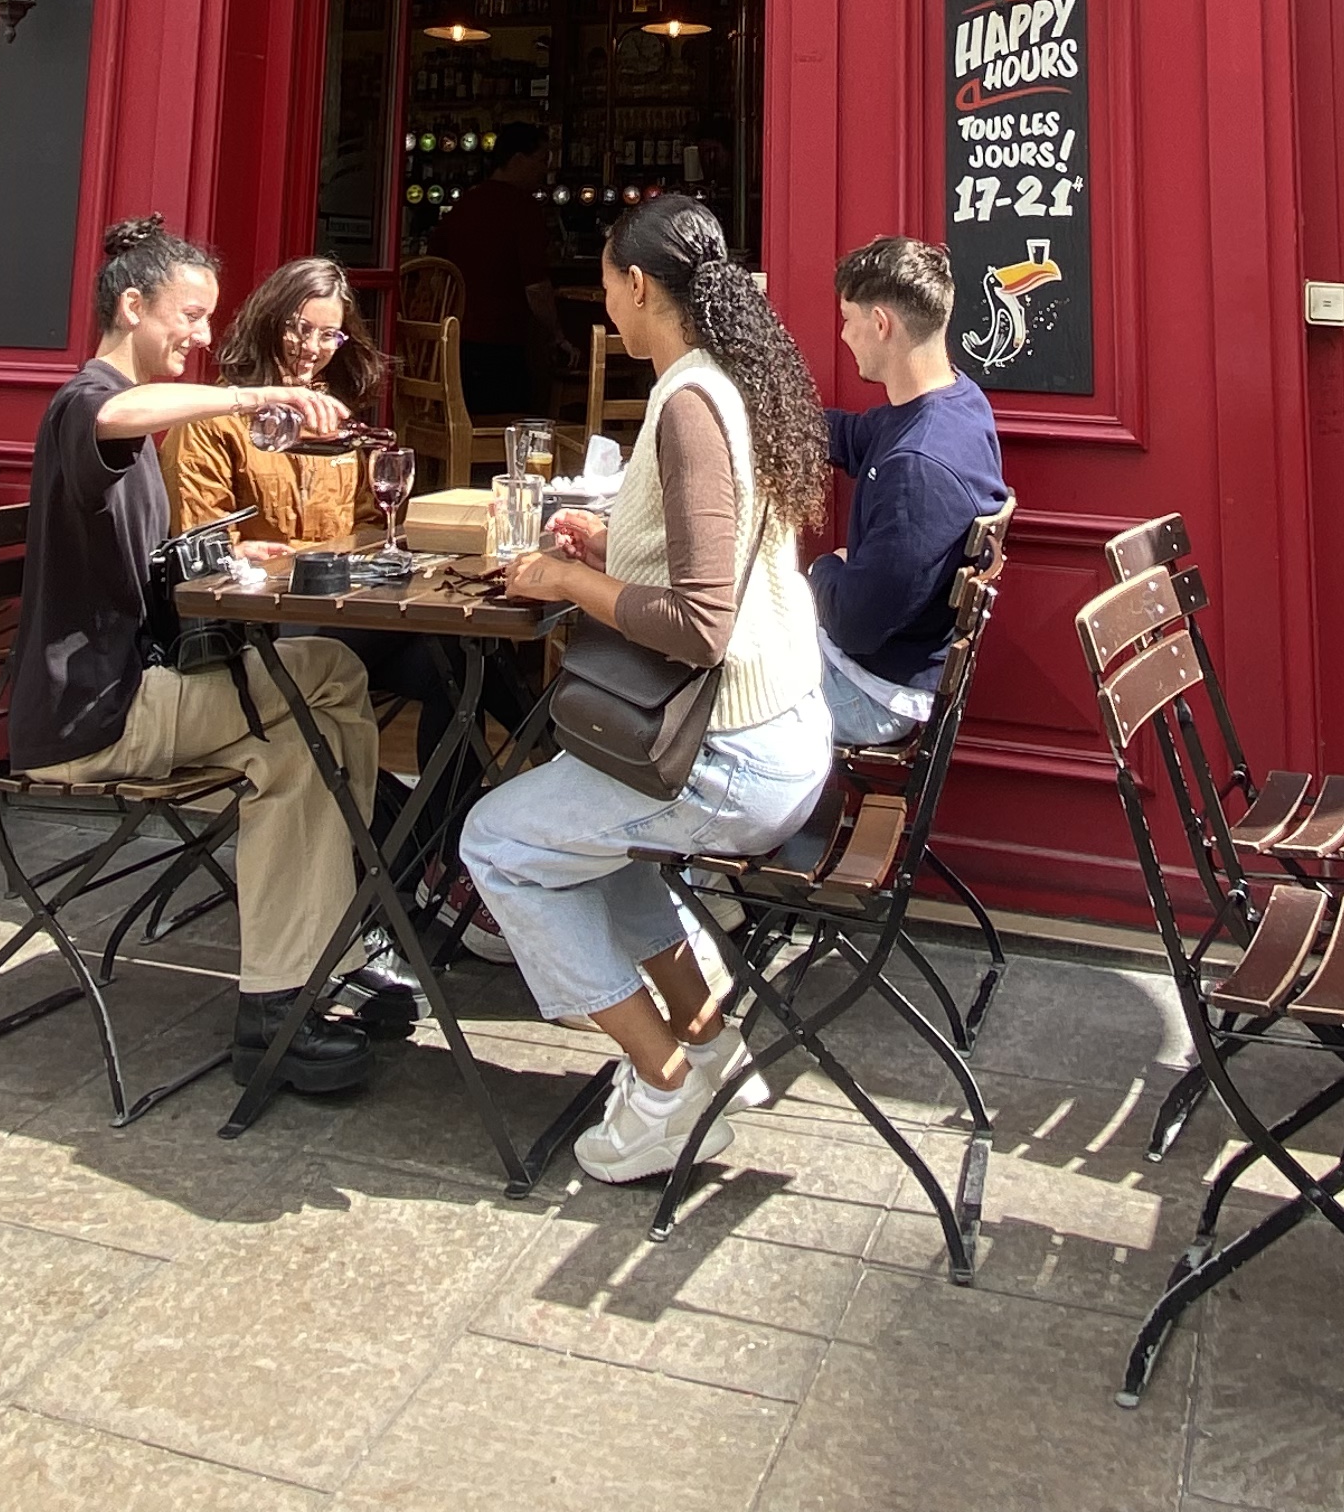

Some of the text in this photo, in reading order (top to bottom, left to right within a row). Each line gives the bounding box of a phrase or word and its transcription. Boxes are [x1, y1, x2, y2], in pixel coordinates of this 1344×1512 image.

[983, 39, 1078, 90] HOURS
[957, 112, 1060, 141] TOUS LES
